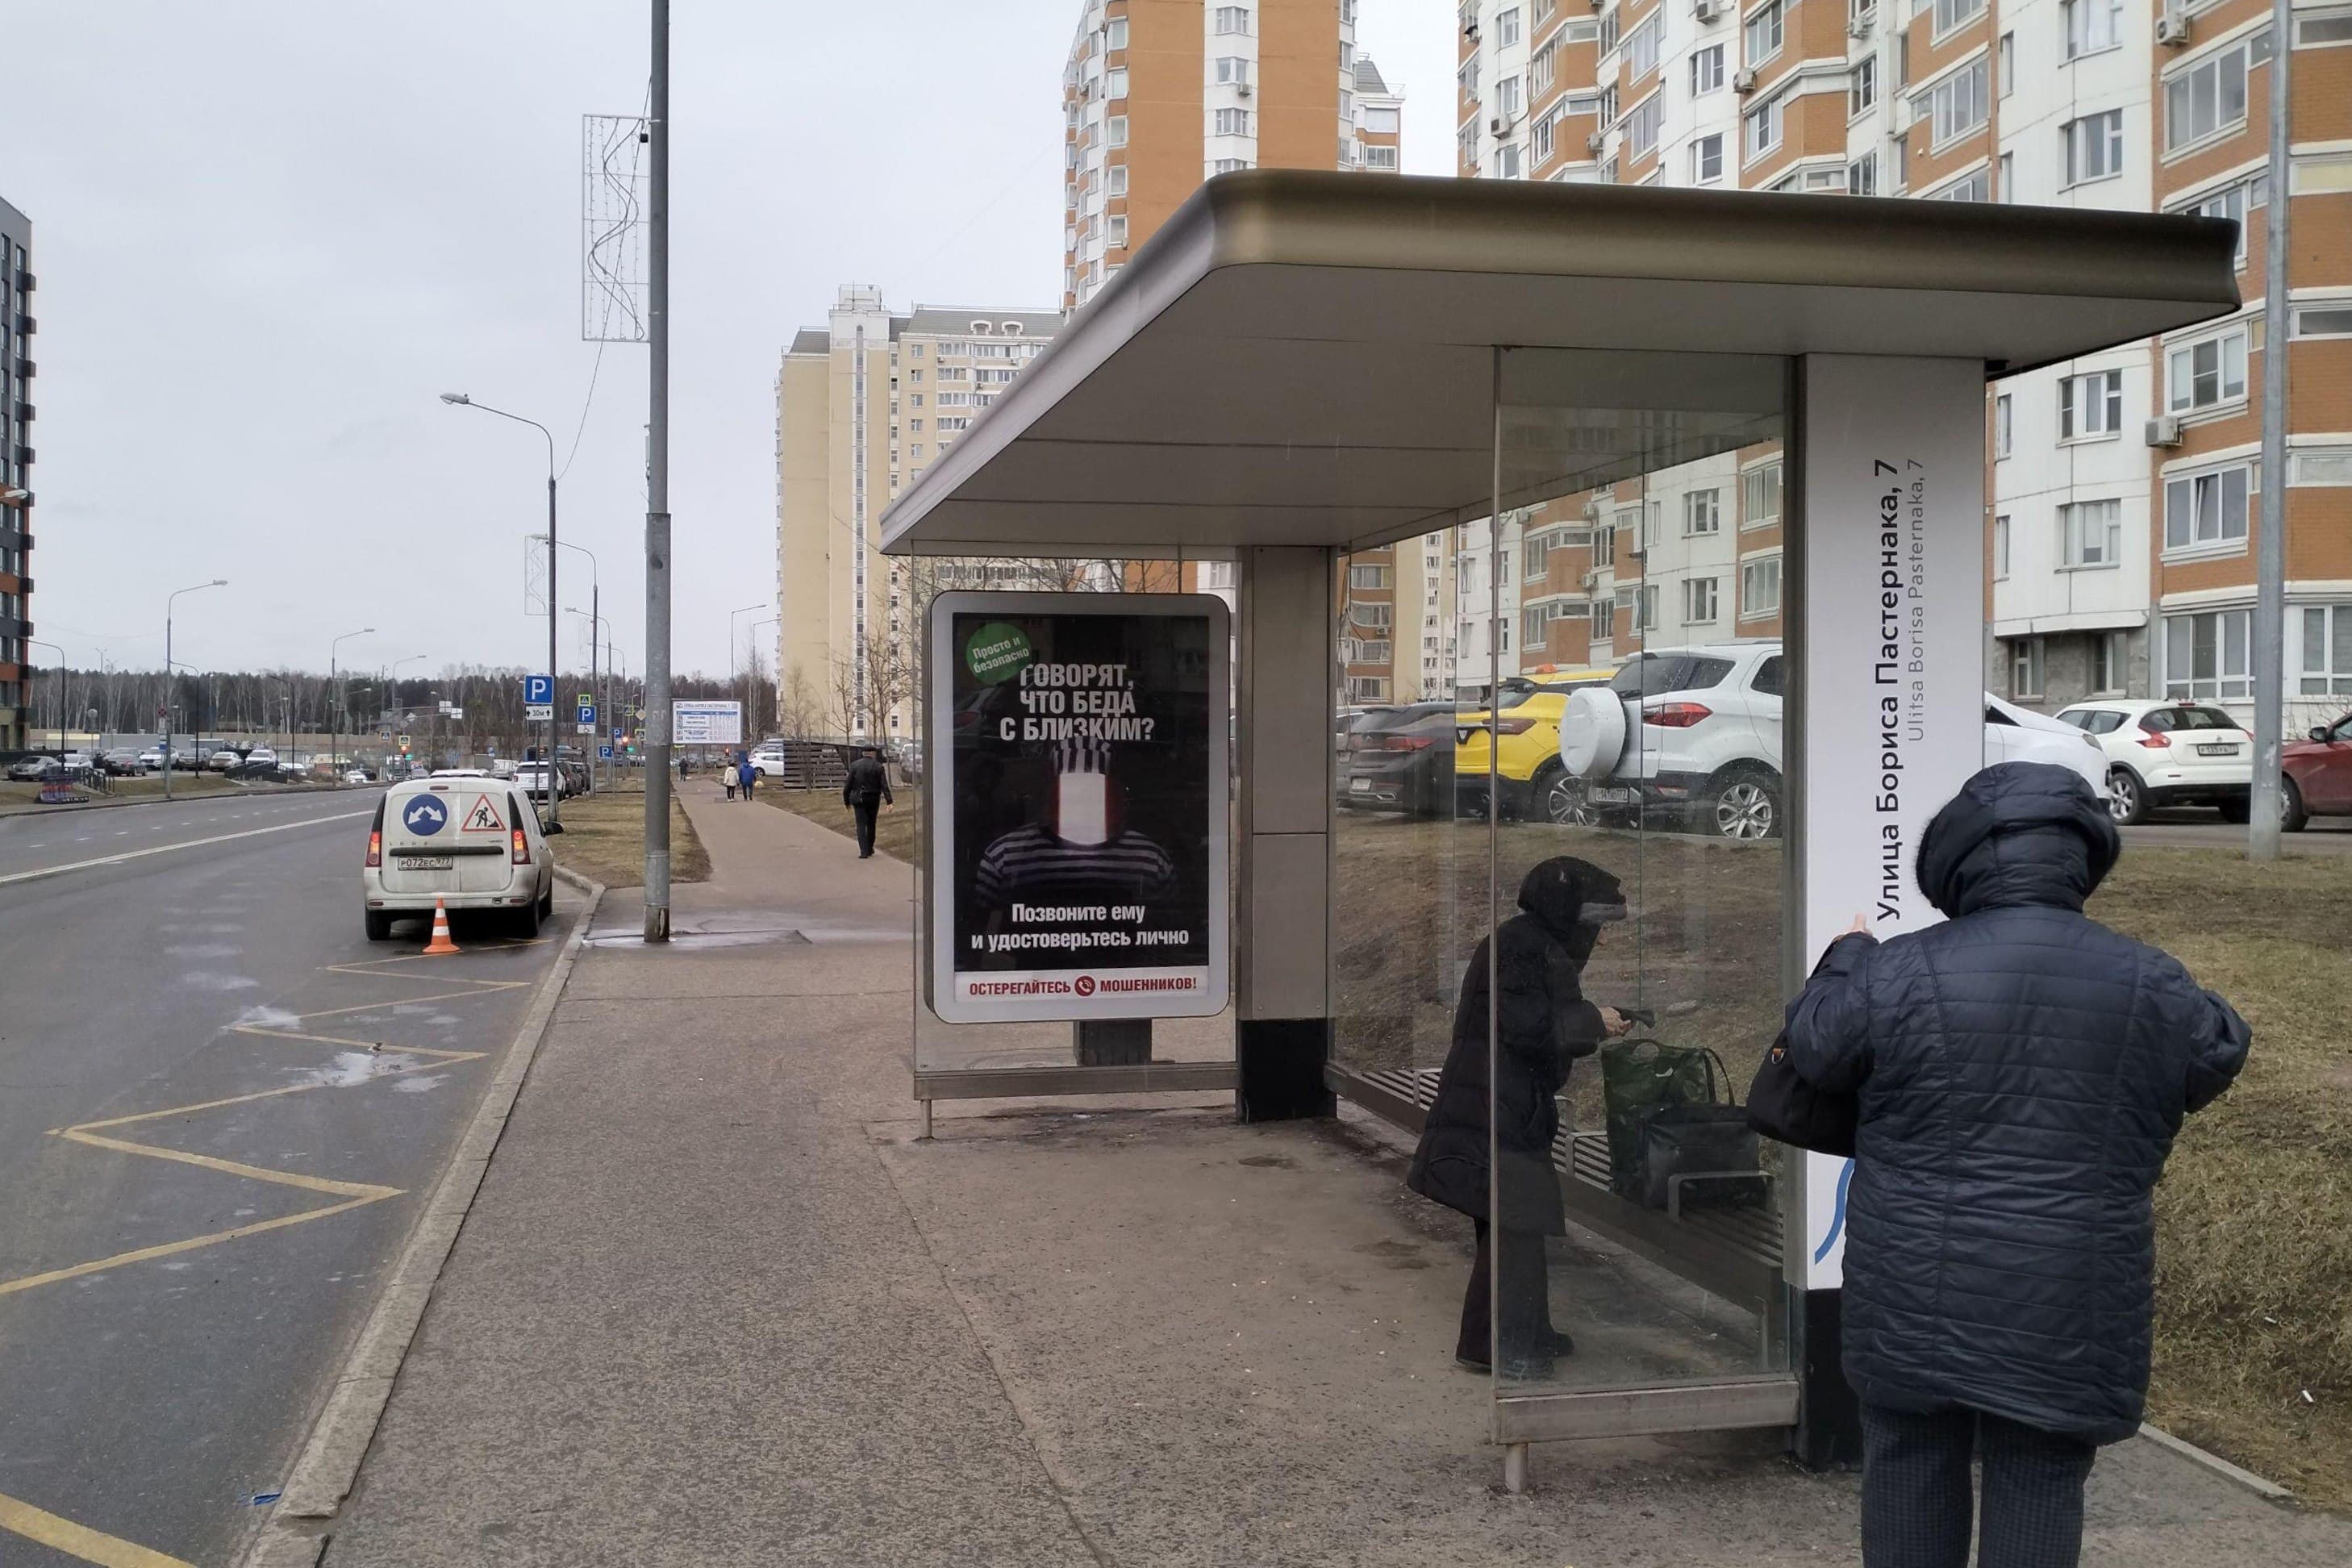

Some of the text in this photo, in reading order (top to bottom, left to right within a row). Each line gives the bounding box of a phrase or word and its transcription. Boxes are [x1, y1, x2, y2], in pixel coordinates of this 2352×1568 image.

[1907, 459, 1925, 741] Ulitsa Borisa Pasternaka, 7
[973, 637, 1020, 659] Просто и
[974, 648, 1030, 673] безопасно
[1020, 663, 1134, 690] ГОВОРЯТ,
[532, 678, 546, 700] P
[1875, 459, 1904, 921] Улица Бориса Пастернака, 7
[582, 707, 591, 721] P
[1020, 690, 1136, 717] ЧТО БЕДА
[1000, 717, 1154, 740] С БЛИЗКИМ?
[1011, 903, 1145, 924] Позвоните ему
[971, 930, 1189, 952] и удостоверьтесь лично
[970, 978, 1197, 995] ОСТЕРЕГАЙТЕСЬ МОШЕННИКОВ!
